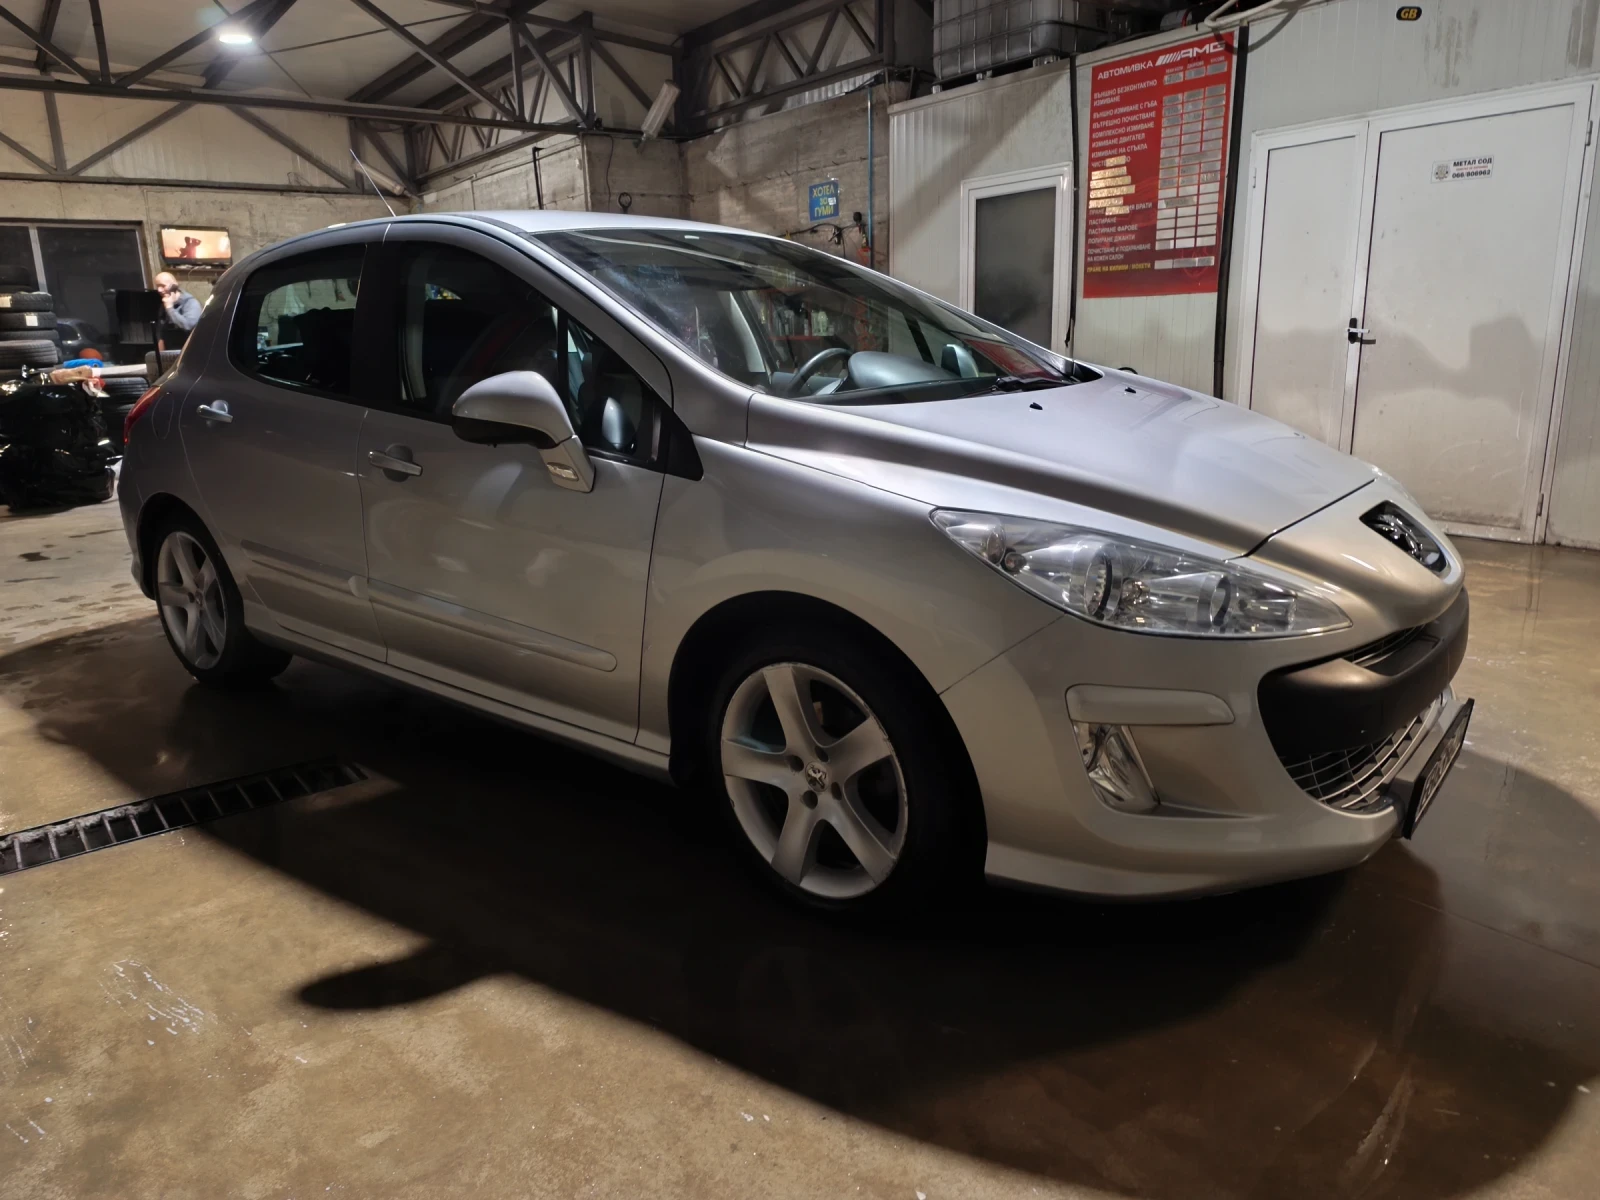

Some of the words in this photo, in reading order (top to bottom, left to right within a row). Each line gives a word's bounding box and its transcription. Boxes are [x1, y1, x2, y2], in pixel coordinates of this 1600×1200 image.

[1400, 8, 1418, 19] GB
[1181, 41, 1225, 58] AMG
[1098, 60, 1153, 80] АВТОМИВКА
[1117, 79, 1157, 94] БЕЗКОНТАКТНО
[1094, 95, 1120, 106] ИЗМИВАНЕ
[1114, 103, 1139, 114] ИЗМИВАНЕ
[1144, 100, 1158, 108] ГЪБА
[1092, 118, 1121, 129] ВЪТРЕШНО
[1121, 111, 1156, 123] ПОЧИСТВАНЕ
[1092, 127, 1126, 138] КОМПЛЕКСНО
[1126, 121, 1154, 132] ИЗМИВАНЕ
[1091, 138, 1118, 148] ИЗМИВАНЕ
[1118, 132, 1145, 144] ДВИГАТЕЛ
[1091, 148, 1118, 158] ИЗМИВАНЕ
[1126, 143, 1148, 152] СТЪКЛА
[1453, 159, 1476, 167] МЕТАЛ
[1477, 157, 1492, 165] СОД
[812, 184, 835, 198] ХОТЕЛ
[814, 205, 834, 217] ГУМИ
[1117, 224, 1138, 232] ФАРОВЕ
